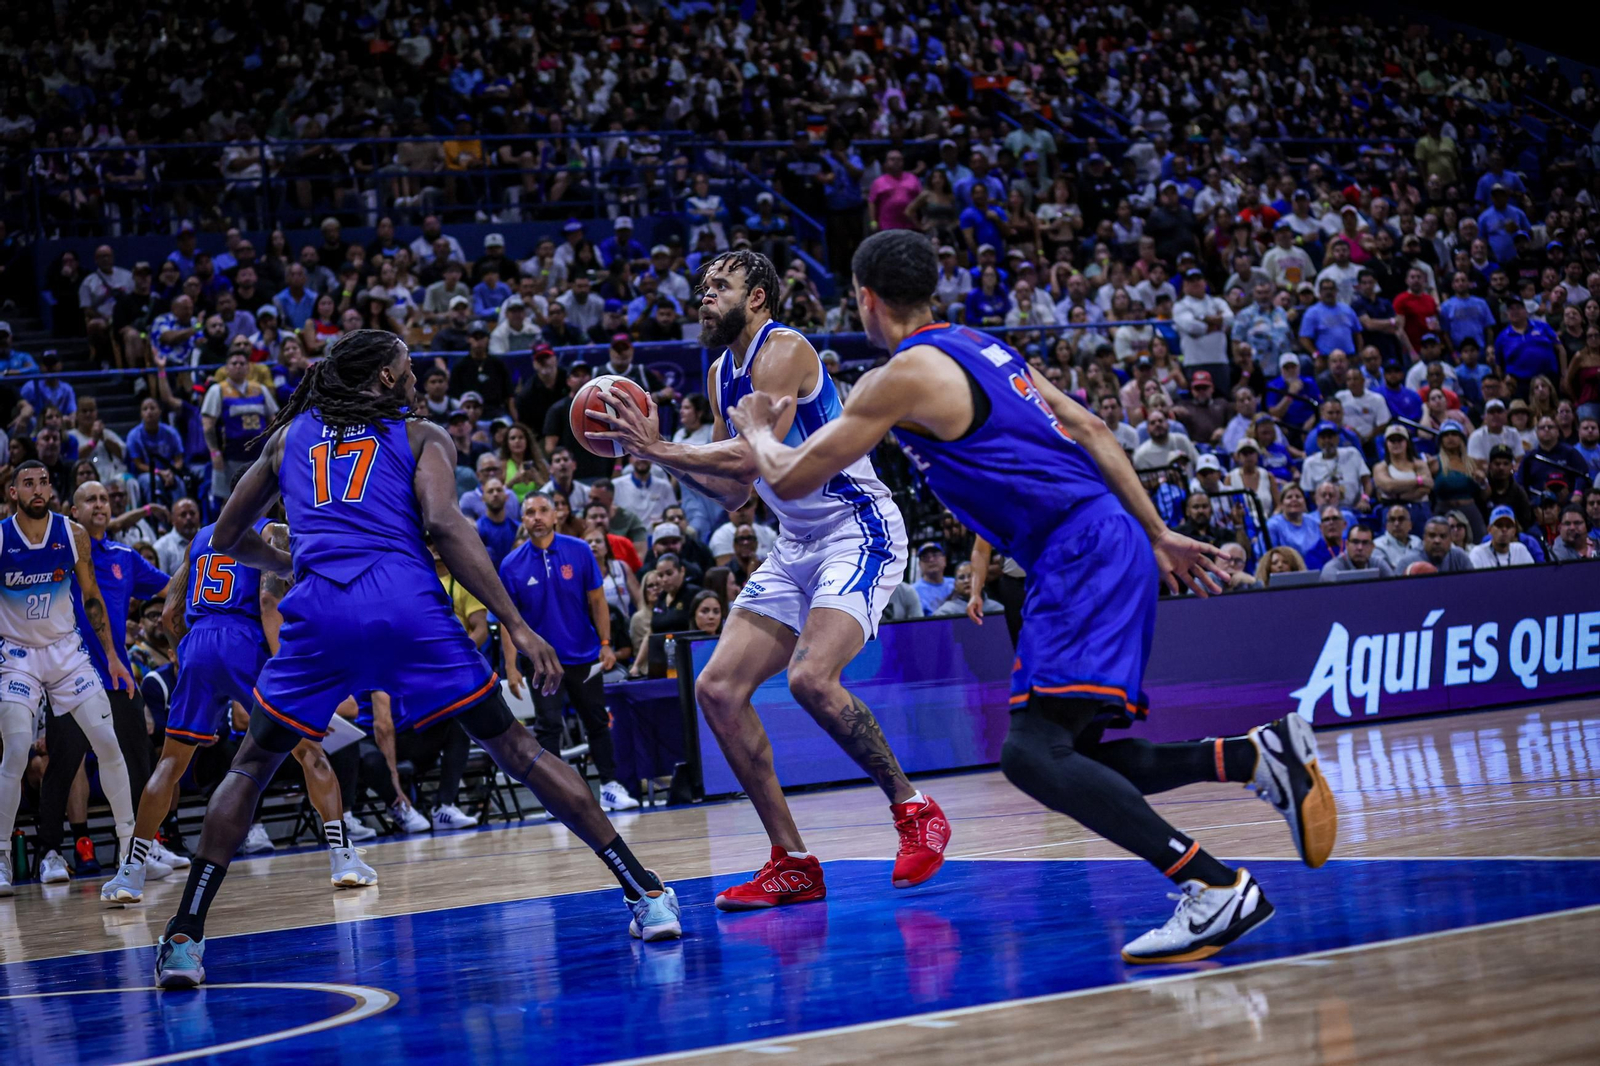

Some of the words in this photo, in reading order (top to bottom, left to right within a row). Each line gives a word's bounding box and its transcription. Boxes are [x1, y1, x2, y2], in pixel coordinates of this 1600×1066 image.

[309, 436, 380, 508] 17
[192, 553, 237, 606] 15
[26, 592, 51, 620] 27
[1444, 622, 1499, 686] ES
[1508, 611, 1600, 689] QUE
[926, 816, 946, 853] AIR
[762, 869, 813, 893] AIR
